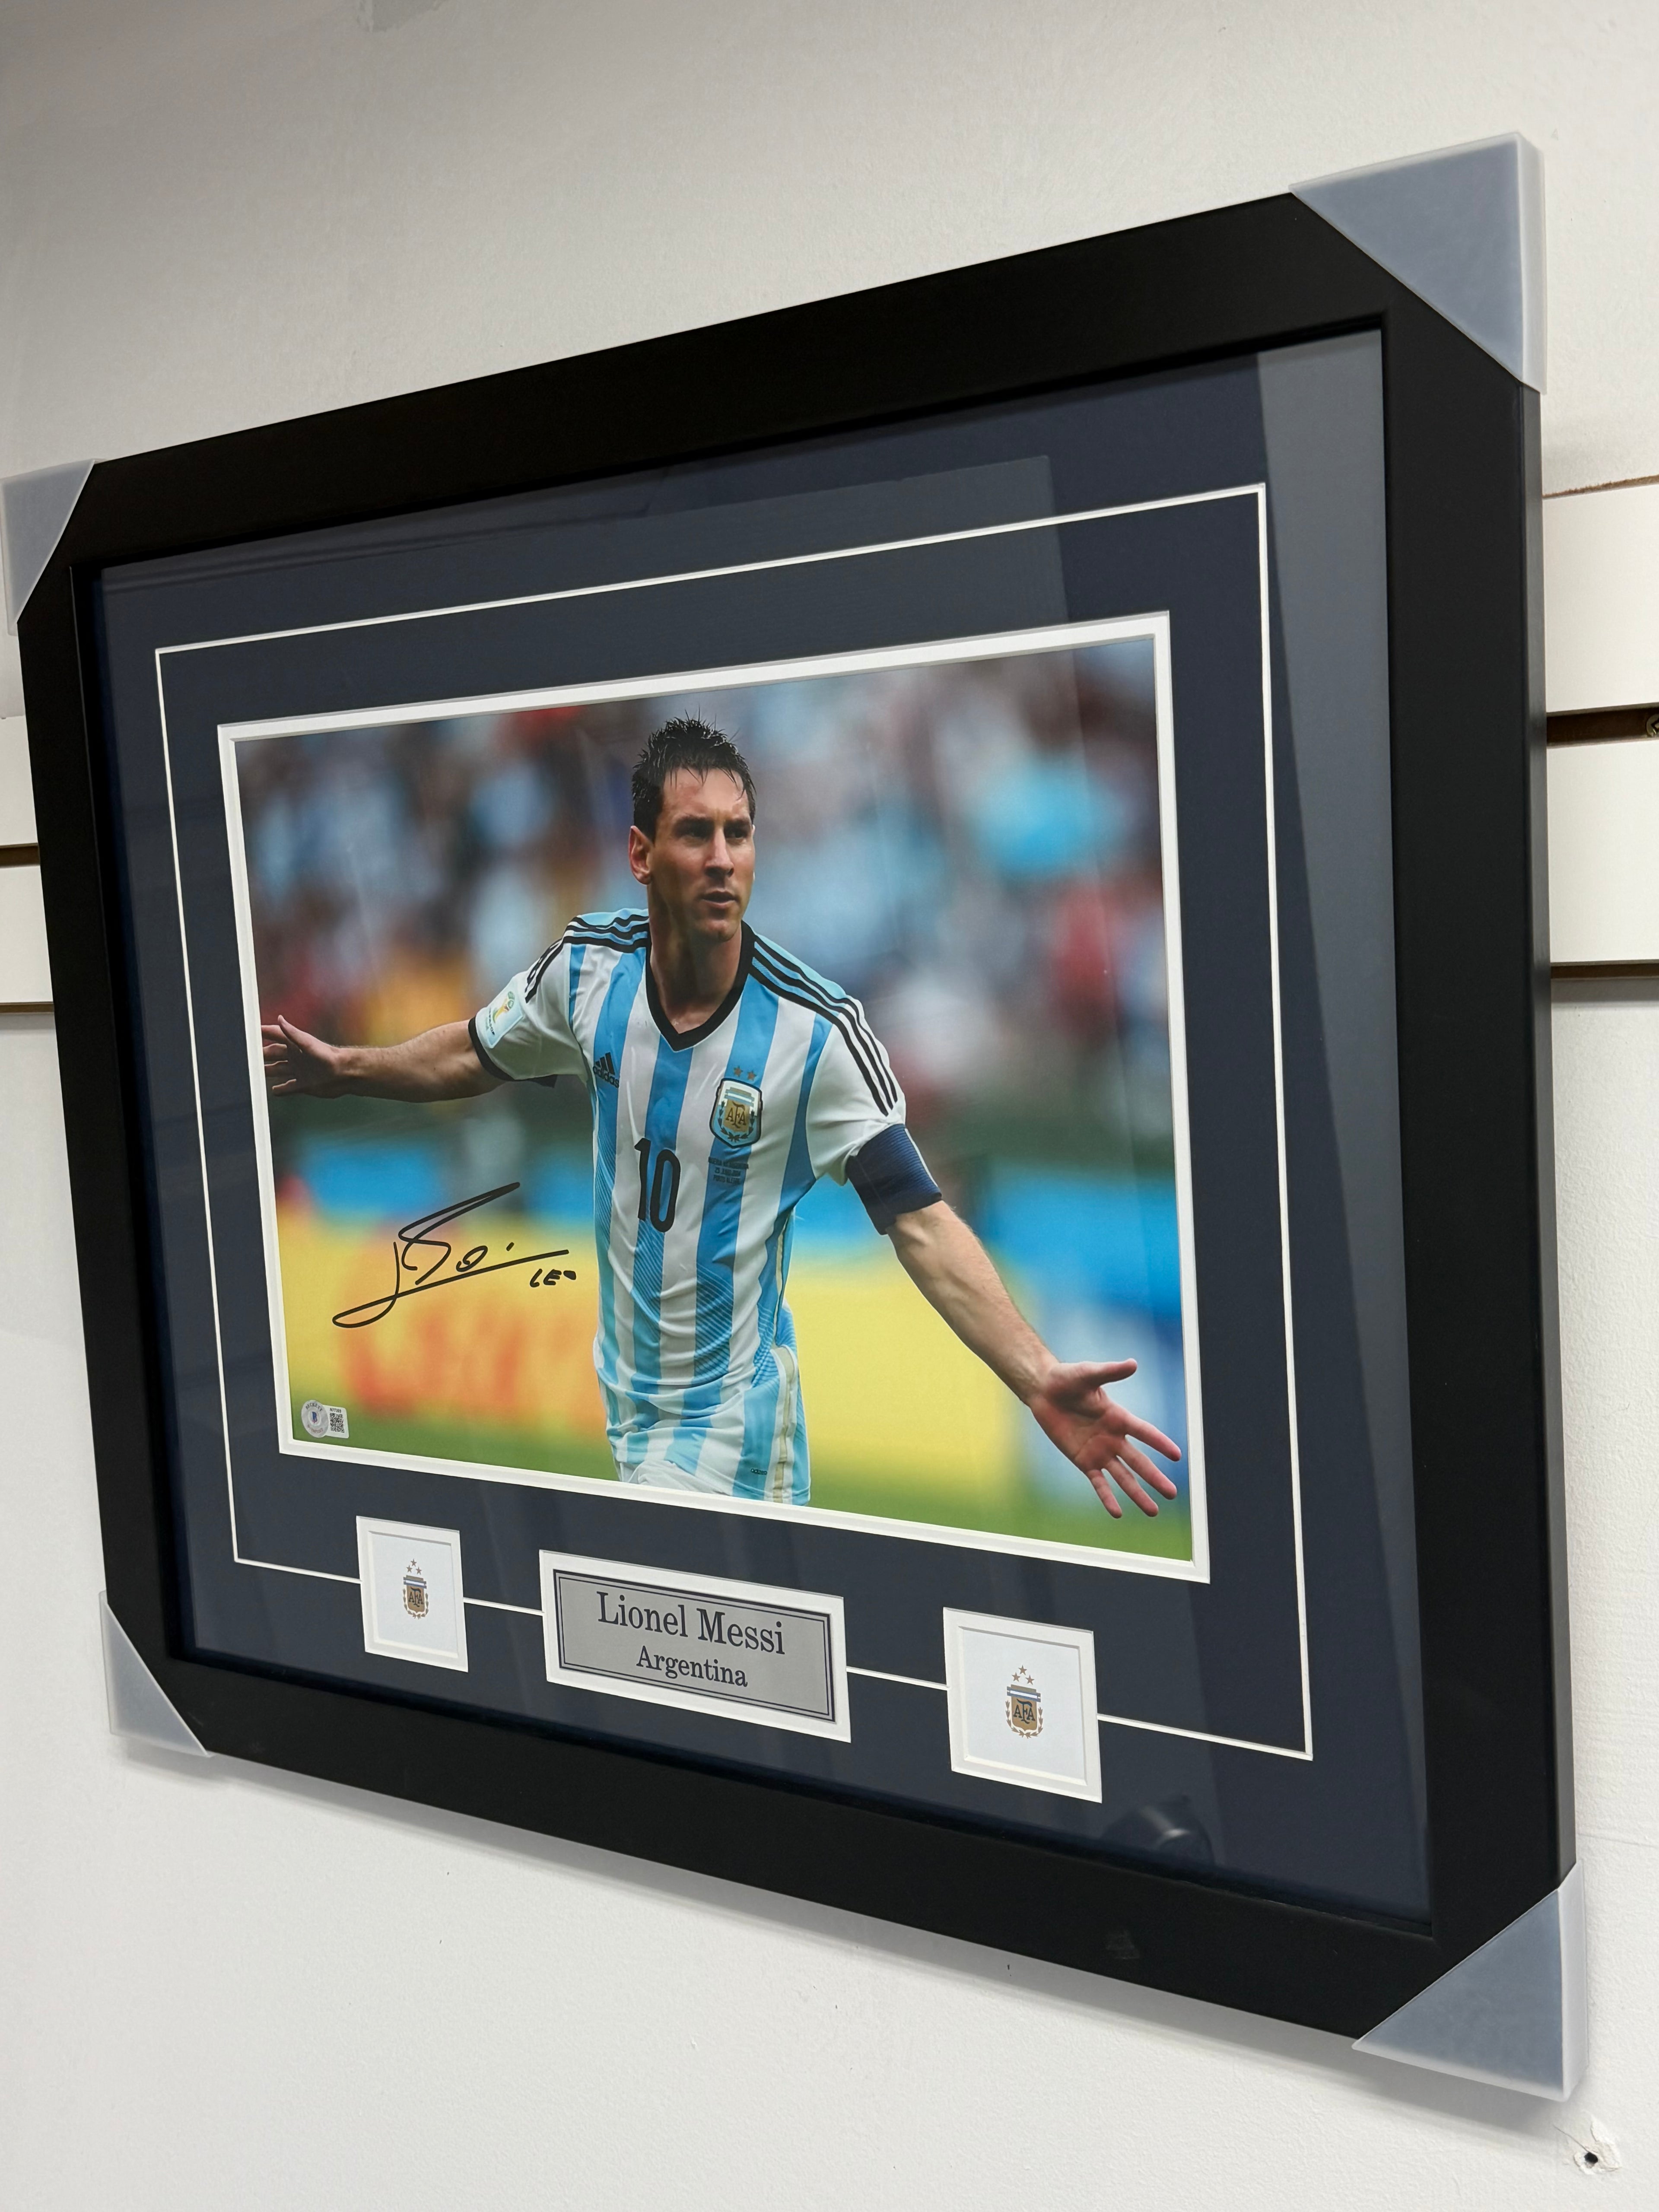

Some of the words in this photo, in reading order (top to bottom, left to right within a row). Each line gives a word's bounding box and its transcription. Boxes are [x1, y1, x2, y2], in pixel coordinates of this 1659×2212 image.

[593, 1066, 620, 1089] adidas
[634, 1138, 681, 1233] 10
[596, 1591, 689, 1637] Lionel
[696, 1608, 785, 1655] Messi
[636, 1645, 748, 1688] Argentina
[1013, 1699, 1036, 1724] AFA
